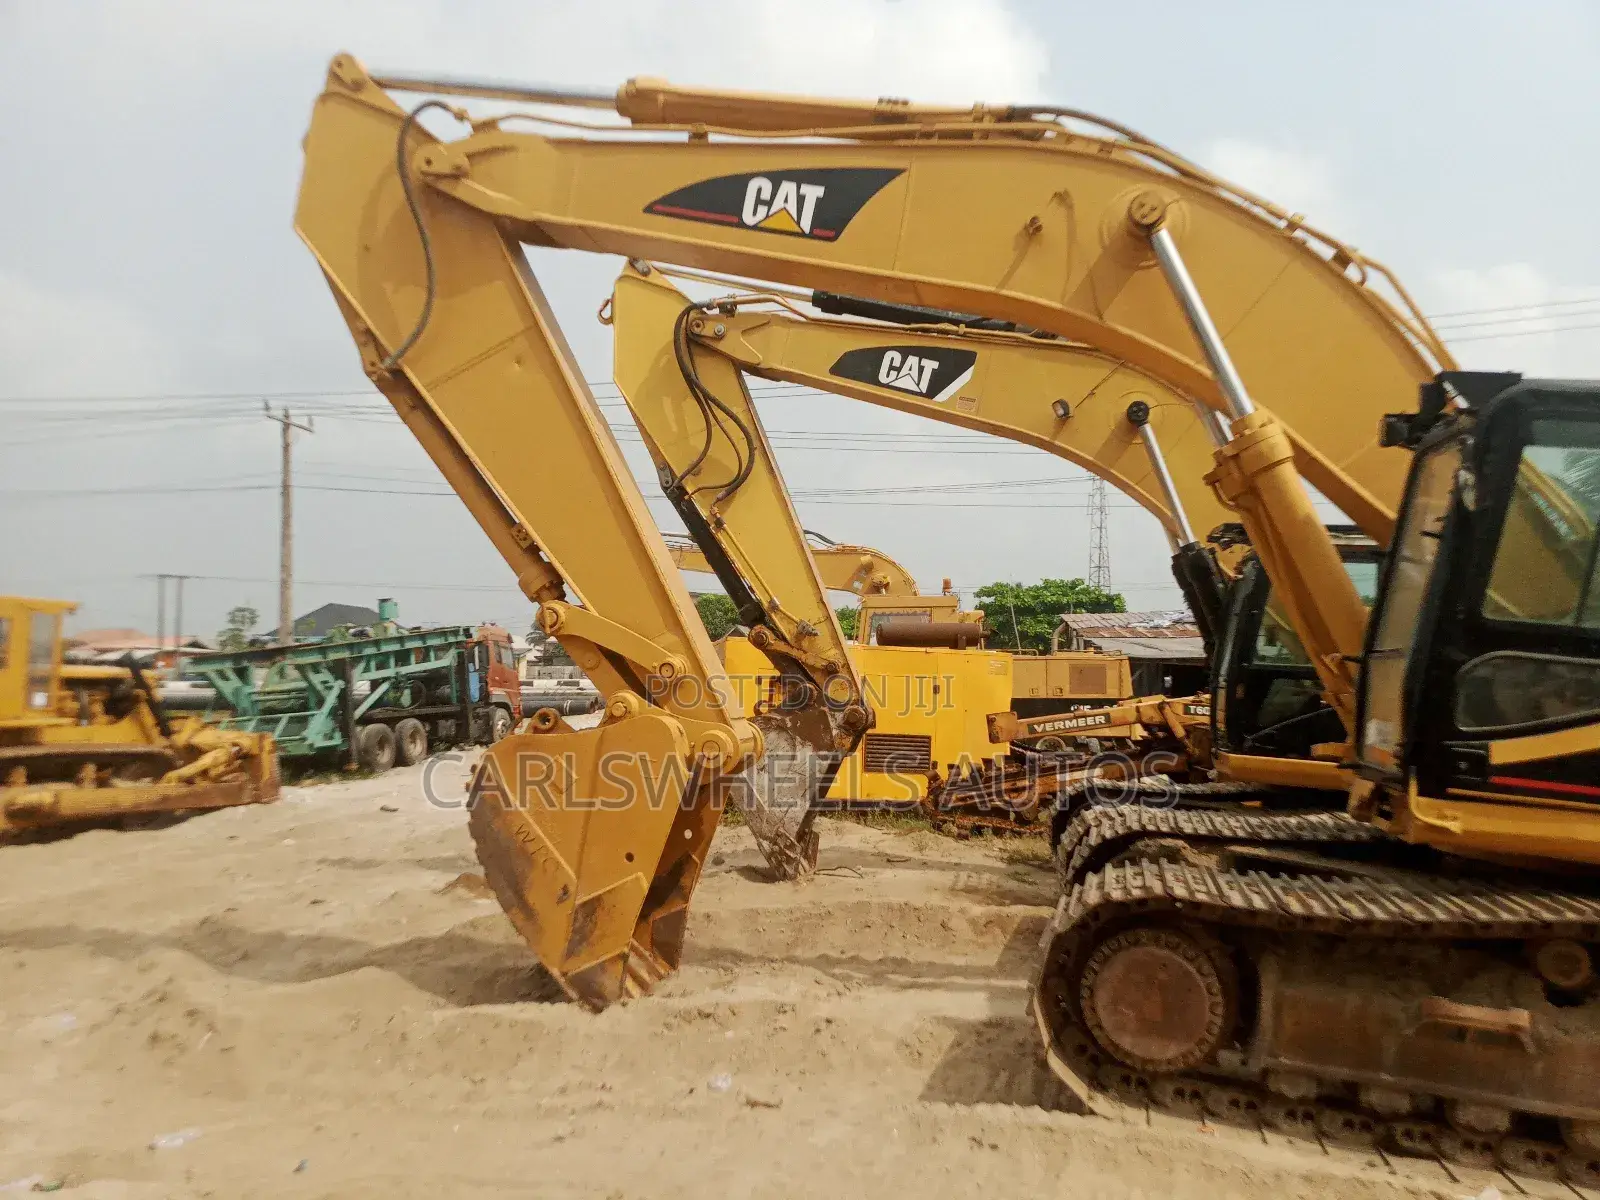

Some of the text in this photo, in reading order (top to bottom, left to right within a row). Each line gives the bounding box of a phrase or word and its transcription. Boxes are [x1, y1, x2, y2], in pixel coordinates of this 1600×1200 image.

[741, 176, 826, 235] CAT
[877, 350, 940, 394] CAT
[1033, 715, 1106, 733] VERMEER
